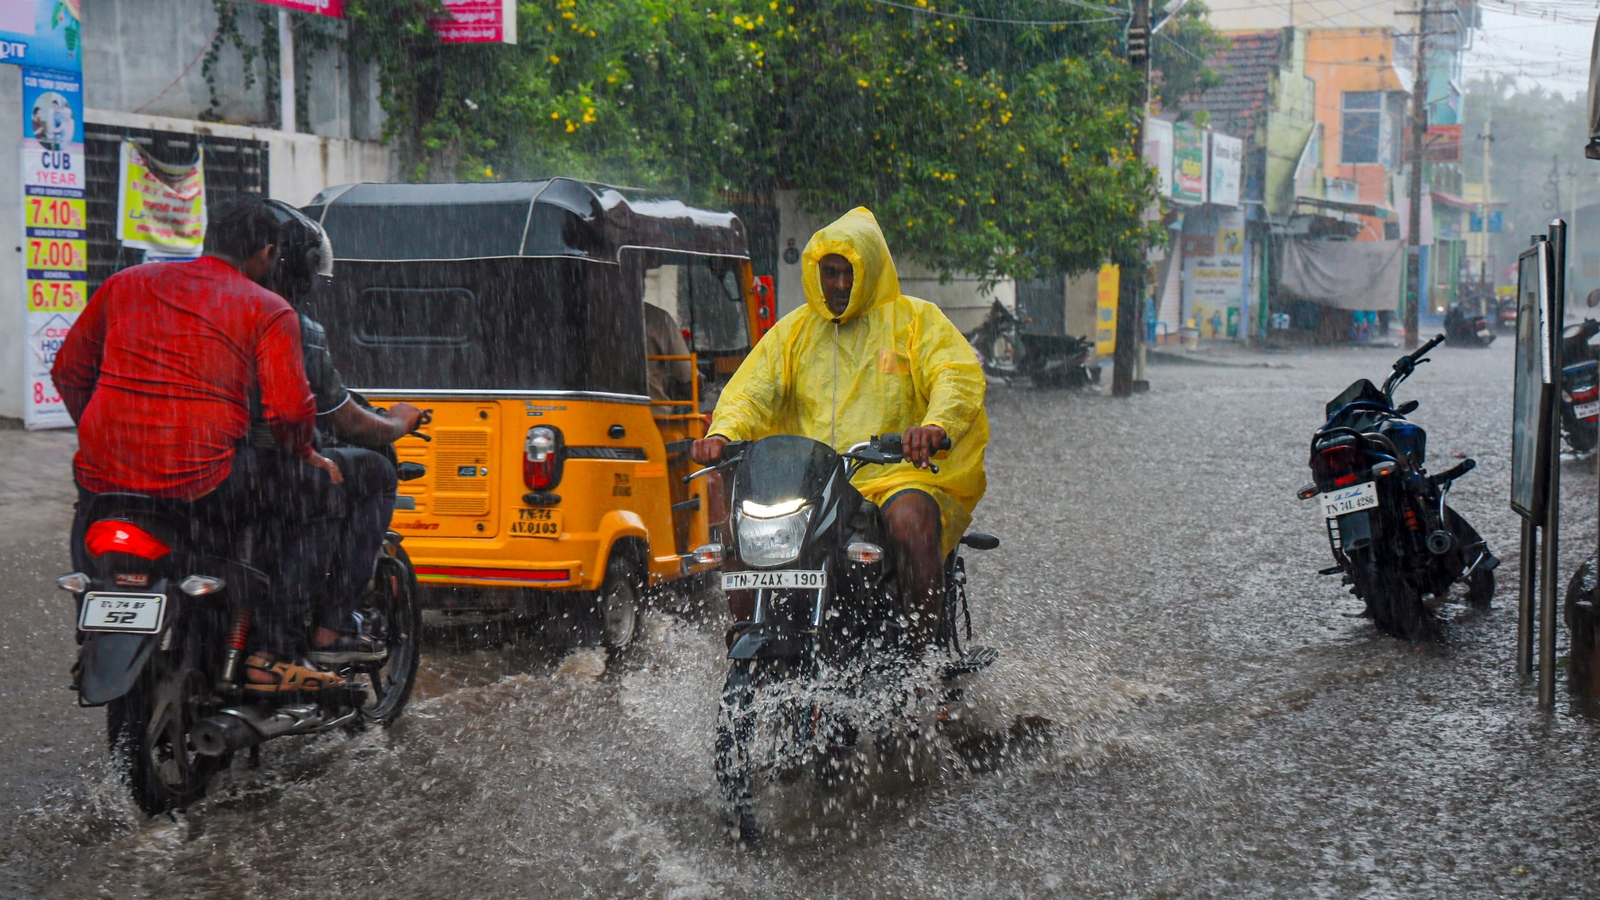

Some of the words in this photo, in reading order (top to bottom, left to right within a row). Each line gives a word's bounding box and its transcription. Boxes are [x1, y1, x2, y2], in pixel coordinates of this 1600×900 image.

[25, 76, 38, 87] CUB
[42, 151, 71, 170] CUB
[34, 229, 55, 237] SENIOR
[56, 230, 79, 238] CITIZEN
[43, 271, 71, 279] GENERAL
[1356, 494, 1375, 507] 4286
[793, 573, 825, 586] 1901
[103, 611, 138, 624] 52
